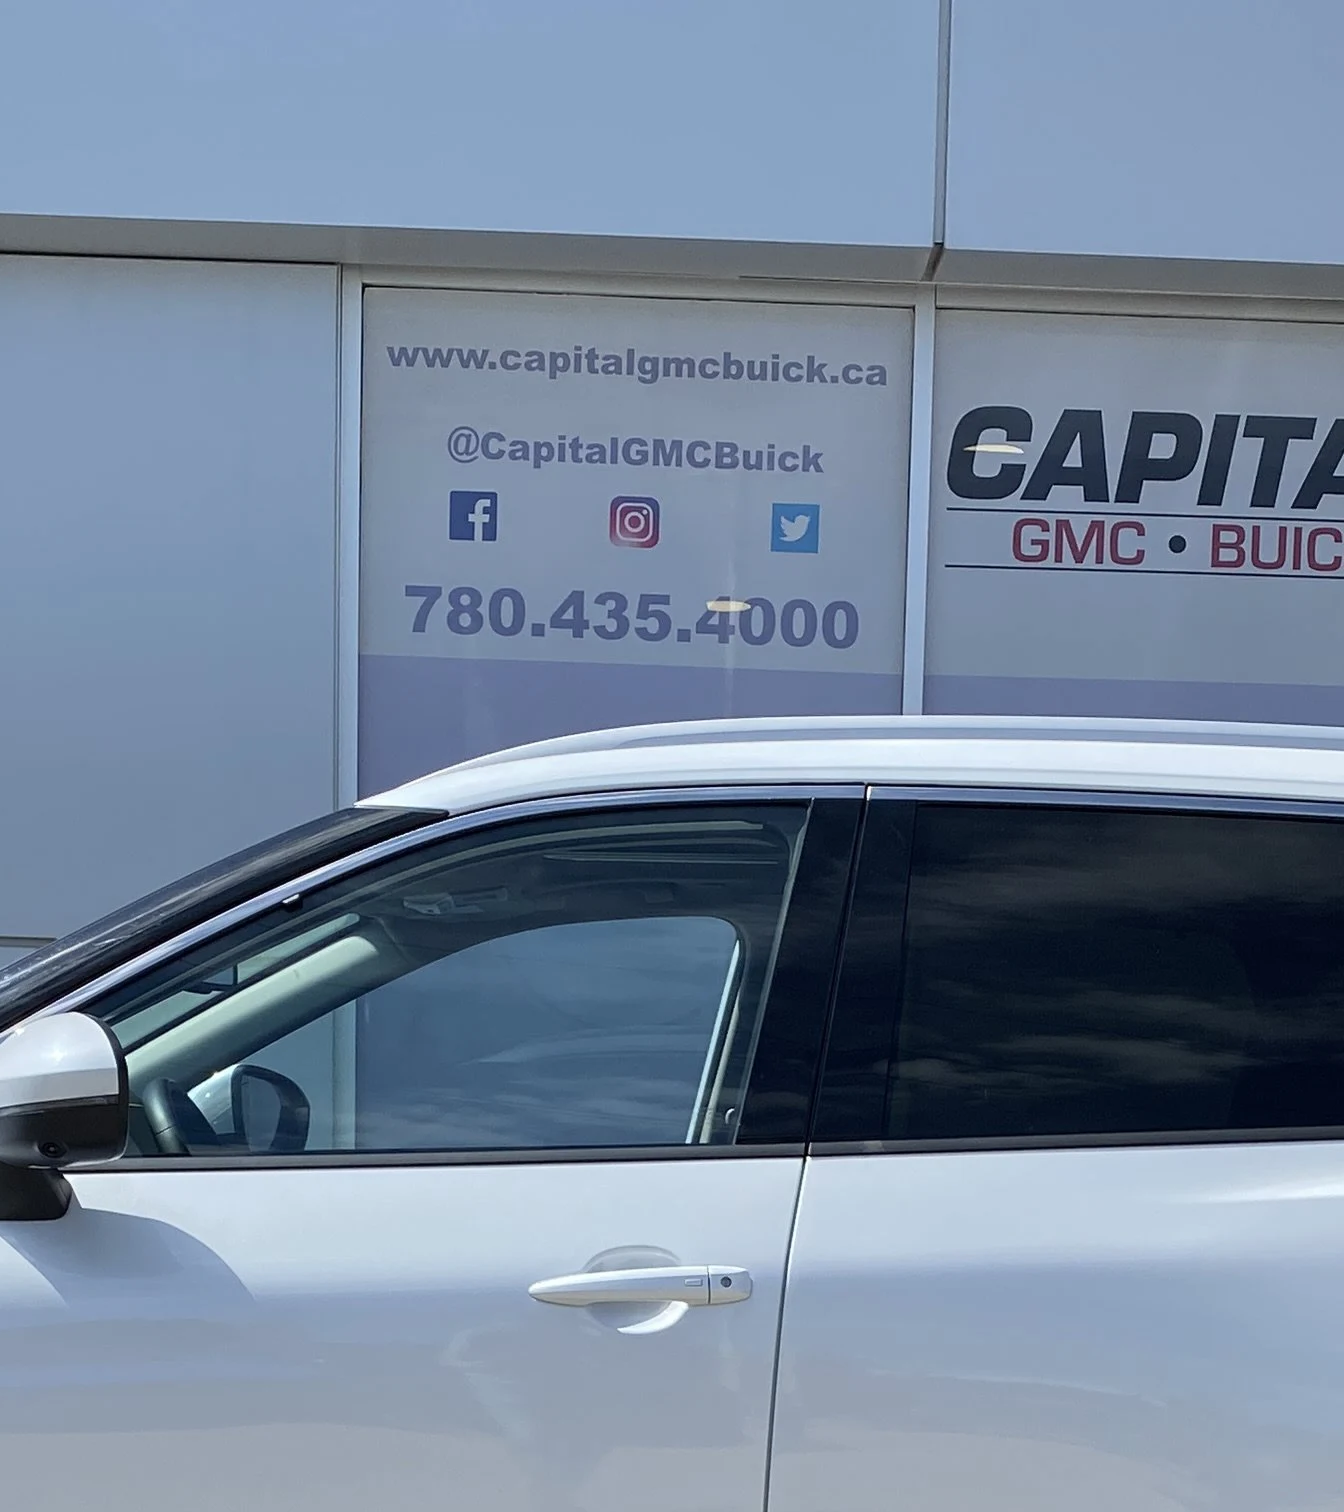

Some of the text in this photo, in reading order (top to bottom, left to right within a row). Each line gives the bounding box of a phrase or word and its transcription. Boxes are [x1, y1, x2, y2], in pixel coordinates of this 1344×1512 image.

[386, 344, 888, 386] www.capitalgmcbuick.ca
[447, 426, 825, 474] @CapitalGMCBuick
[1012, 518, 1146, 566] GMC
[404, 584, 860, 650] 780.435.4000
